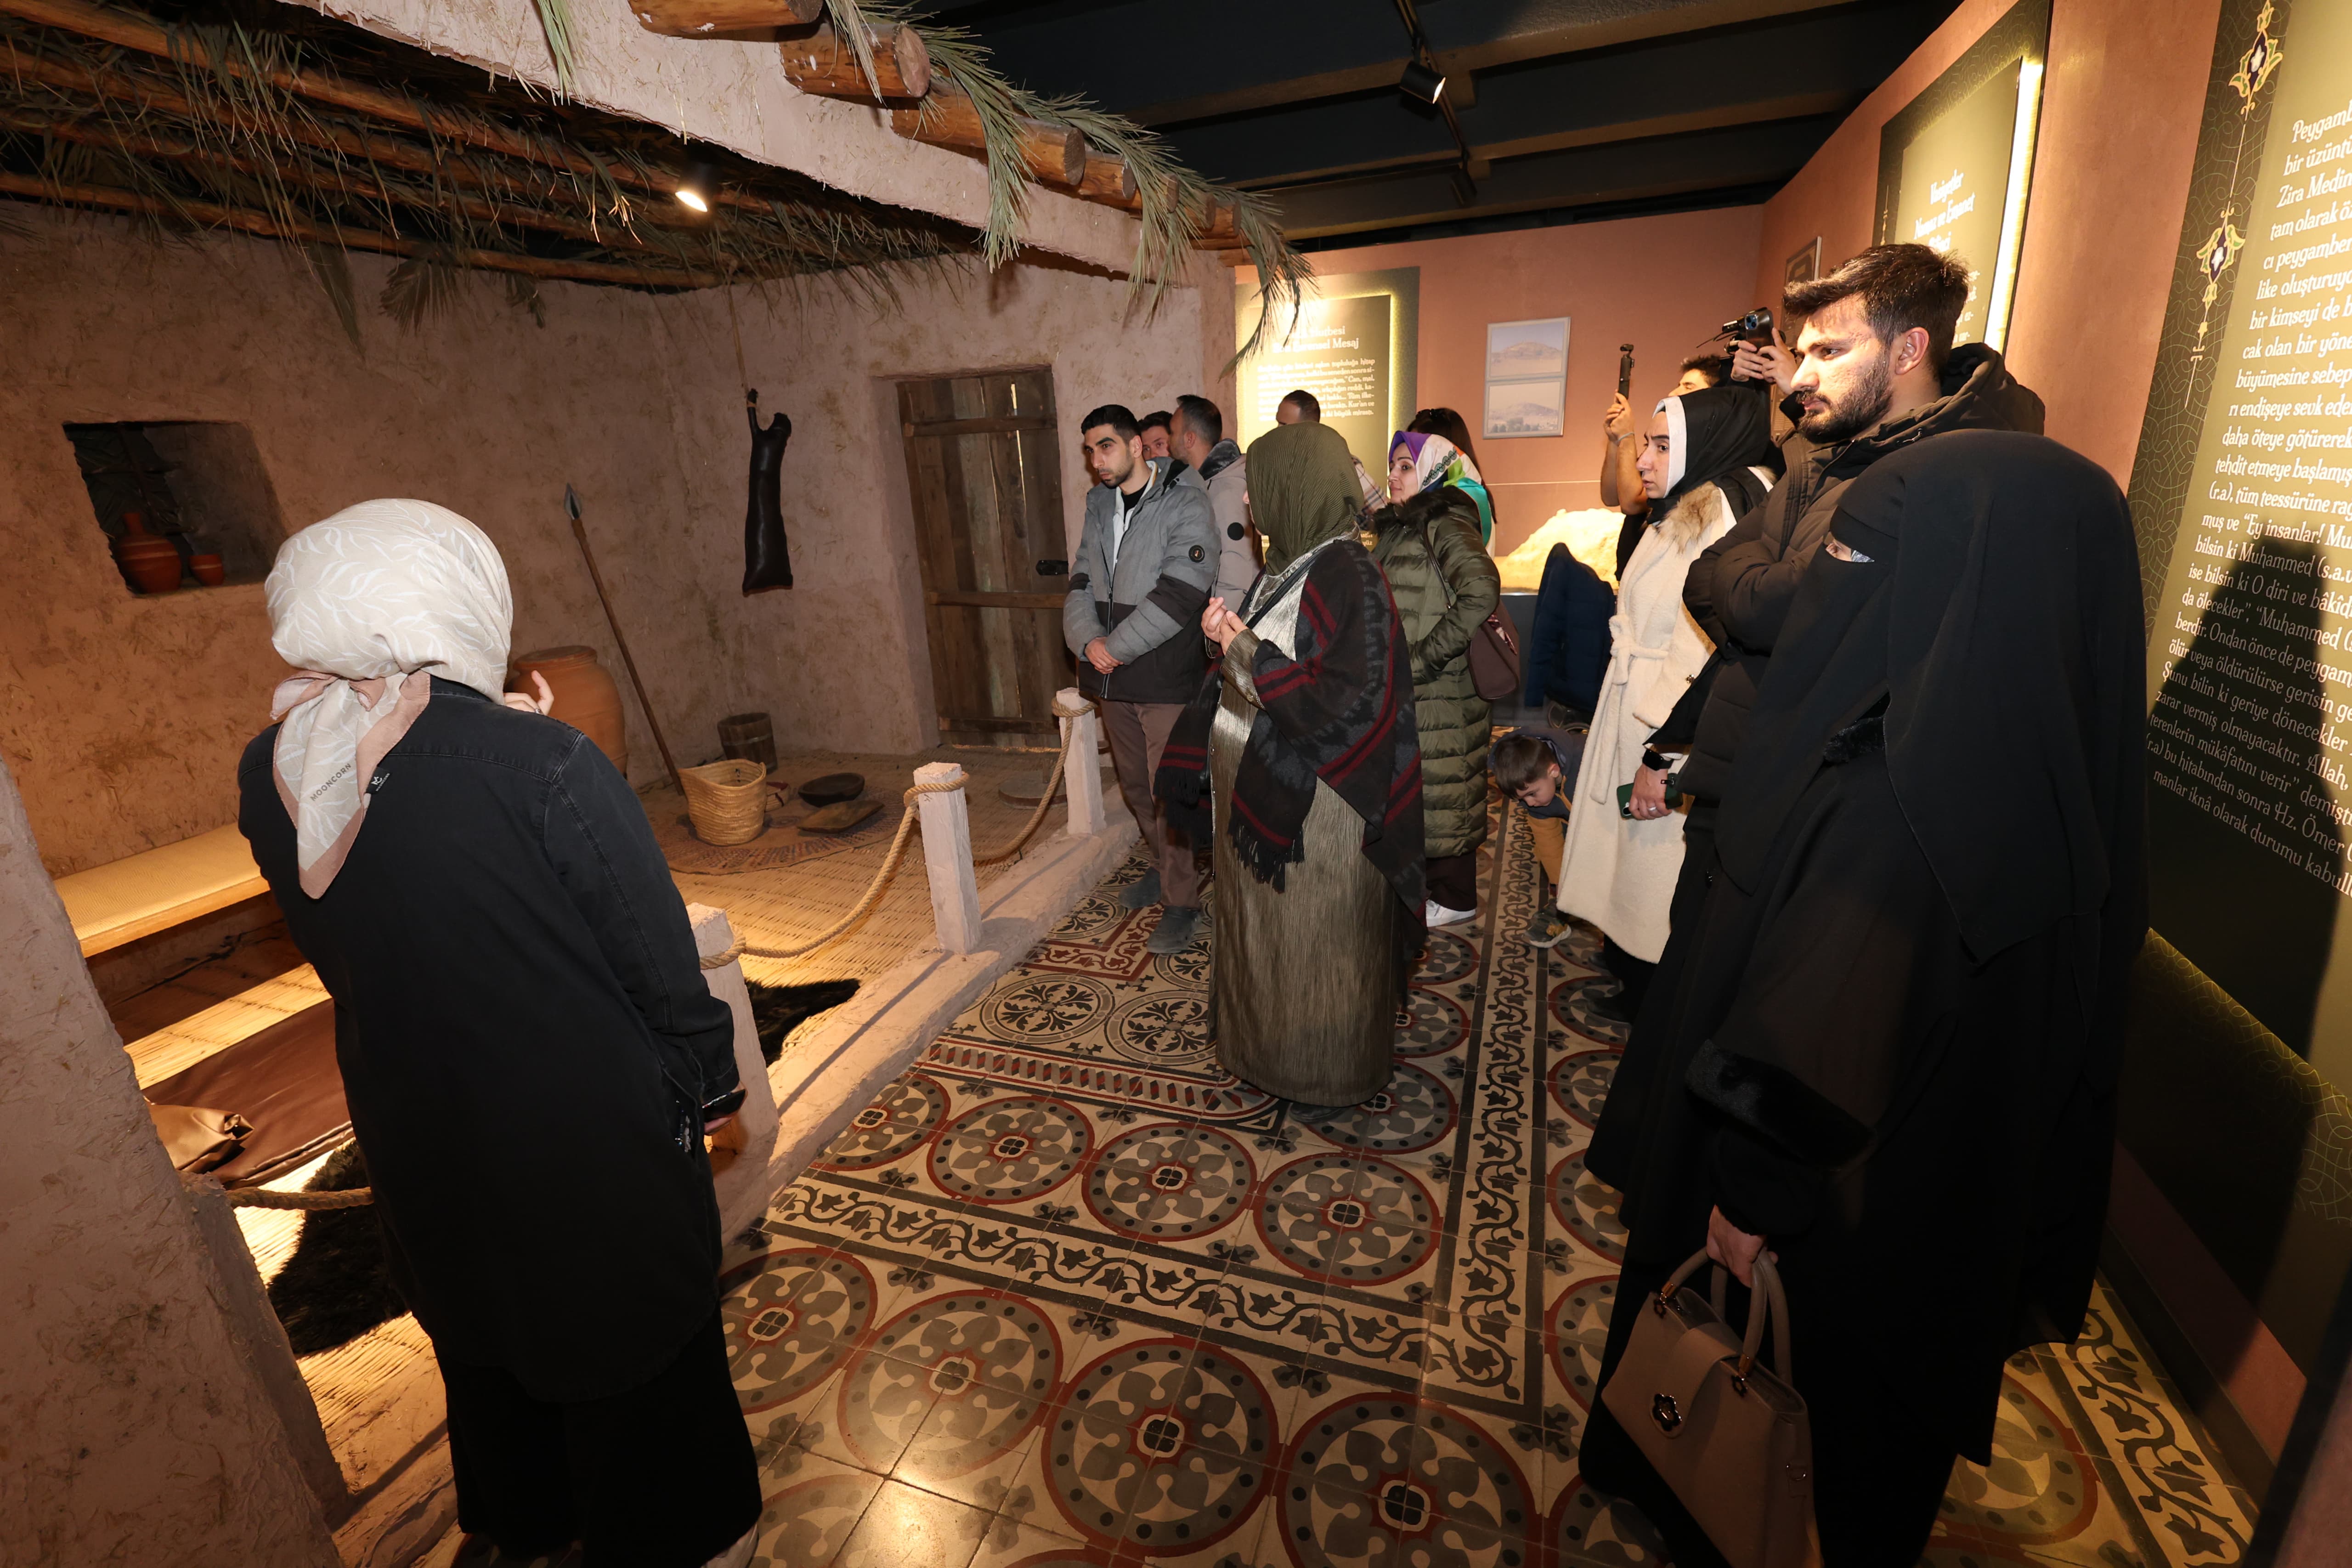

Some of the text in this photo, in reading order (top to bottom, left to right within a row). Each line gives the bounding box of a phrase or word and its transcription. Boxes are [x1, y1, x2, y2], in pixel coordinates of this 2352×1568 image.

[2292, 98, 2352, 143] Peygam
[2283, 154, 2304, 176] bir
[2276, 184, 2304, 208] Zira
[2270, 223, 2294, 241] tam
[2295, 201, 2339, 232] olarak
[2263, 256, 2274, 270] cı
[2256, 278, 2278, 300] like
[2249, 310, 2268, 330] bir
[2268, 302, 2321, 328] kimseyi
[2322, 297, 2340, 321] de
[1333, 338, 1359, 350] Mesaj
[2242, 338, 2262, 359] cak
[2265, 336, 2292, 357] olan
[2295, 333, 2317, 354] bir
[2235, 361, 2352, 393] büyümesine sebep
[2239, 396, 2292, 421] endişeye
[2293, 394, 2324, 416] sevk
[2222, 425, 2249, 447] daha
[2251, 429, 2284, 452] öteye
[2215, 454, 2352, 487] tehdit etmeye başlamış
[2209, 481, 2233, 503] (r.a),
[2235, 487, 2259, 506] tüm
[2260, 490, 2330, 513] teessürüne
[2201, 515, 2224, 533] muş
[2227, 518, 2240, 531] ve
[2265, 519, 2326, 544] insanlar!
[2195, 534, 2224, 557] bilsin
[2225, 540, 2239, 560] ki
[2239, 542, 2316, 577] Muhammed
[2188, 563, 2203, 580] ise
[2204, 564, 2234, 588] bilsin
[2237, 572, 2249, 591] ki
[2252, 575, 2264, 594] O
[2266, 579, 2290, 601] diri
[2292, 591, 2307, 606] ve
[2182, 587, 2194, 606] da
[2256, 605, 2342, 651] “Muhammed
[2174, 611, 2207, 637] berdir.
[2210, 623, 2247, 651] Ondan
[2248, 637, 2277, 661] önce
[2278, 645, 2294, 667] de
[2169, 639, 2190, 659] ölür
[2190, 651, 2214, 671] veya
[2216, 656, 2284, 694] öldürülürse
[2285, 686, 2334, 713] gerisin
[2162, 661, 2349, 752] Şunu bilin ki geriye dönecekler
[2150, 713, 2195, 746] terenlerin
[2197, 740, 2257, 777] mükâfatını
[2155, 691, 2349, 791] zarar vermiş olmayacaktır. Allah,
[310, 763, 351, 801] MOONCORN
[2163, 743, 2177, 764] bu
[2178, 751, 2235, 795] hitabından
[2237, 788, 2271, 816] sonra
[2275, 802, 2297, 831] Hz.
[2302, 813, 2345, 855] Ömer
[2154, 771, 2188, 797] manlar
[2188, 786, 2212, 812] iknâ
[2213, 803, 2249, 834] olarak
[2250, 823, 2302, 866] durumu
